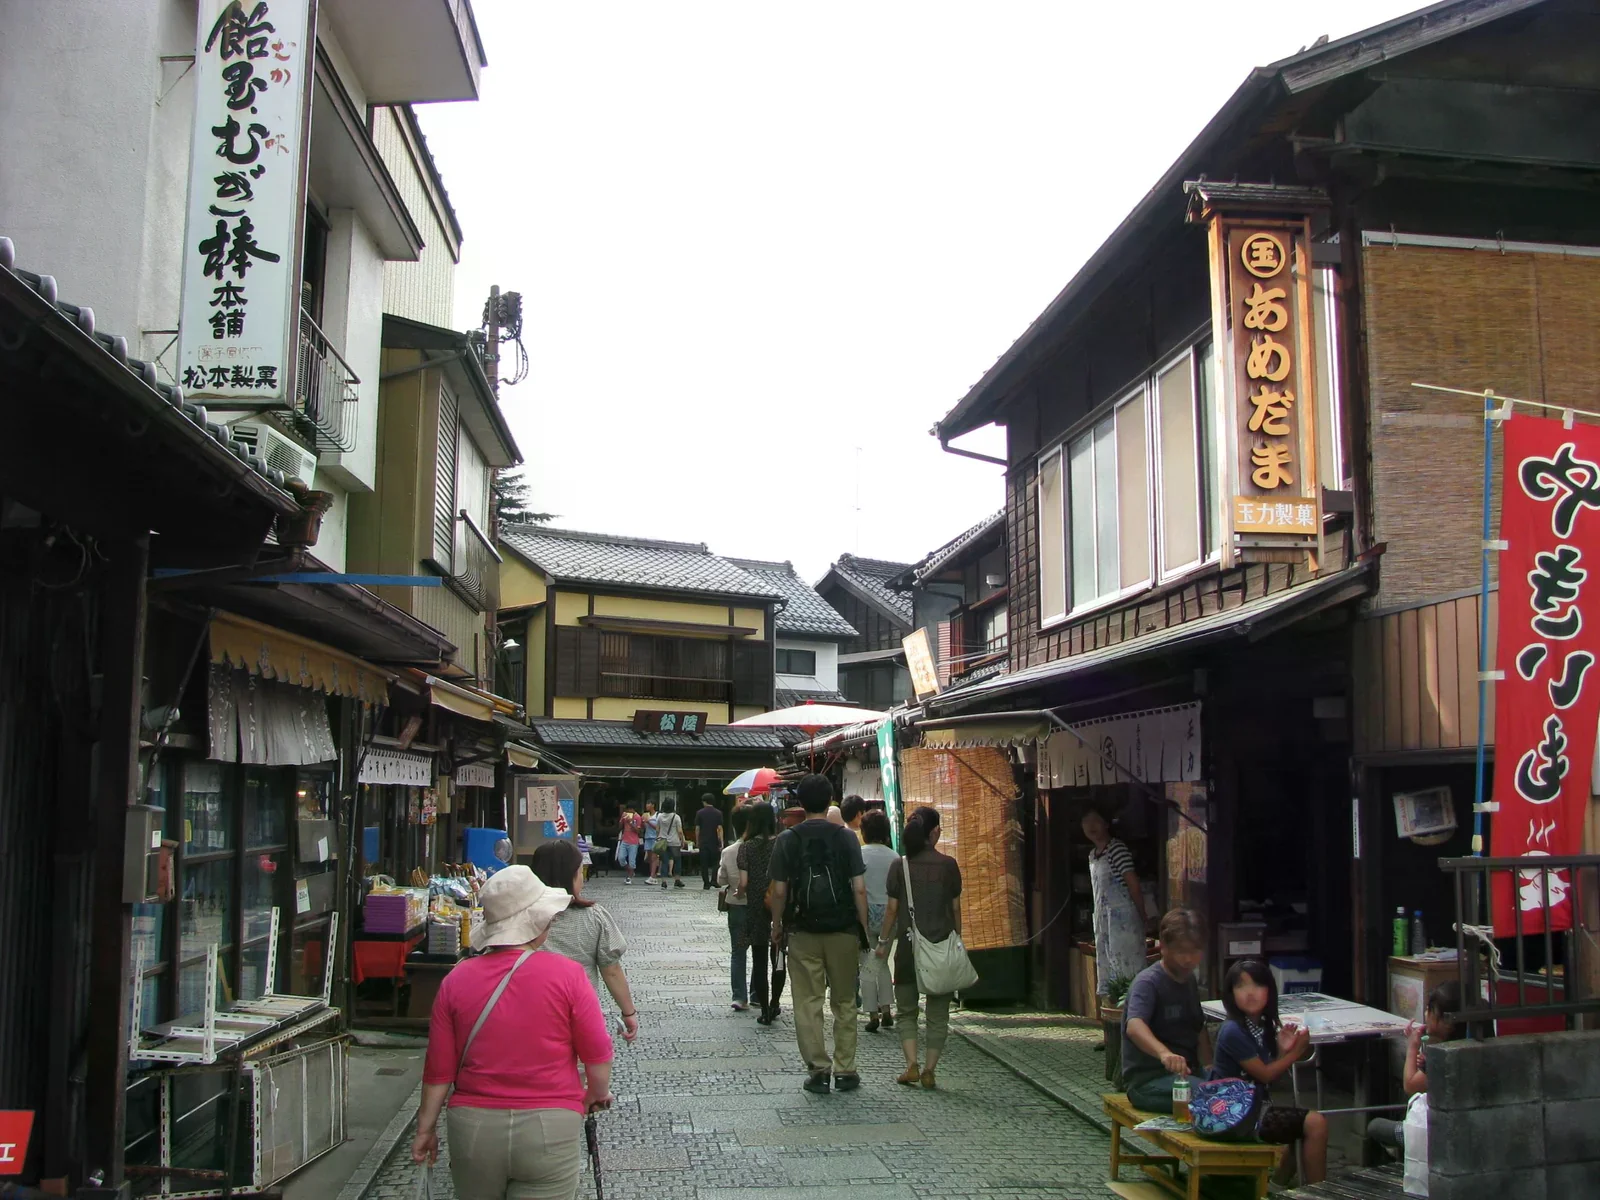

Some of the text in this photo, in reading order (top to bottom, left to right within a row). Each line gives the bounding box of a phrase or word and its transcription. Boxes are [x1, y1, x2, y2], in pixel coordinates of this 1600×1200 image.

[181, 364, 278, 390] 松本製菓
[1244, 282, 1295, 490] あめだま
[1237, 502, 1314, 527] 玉力製菓
